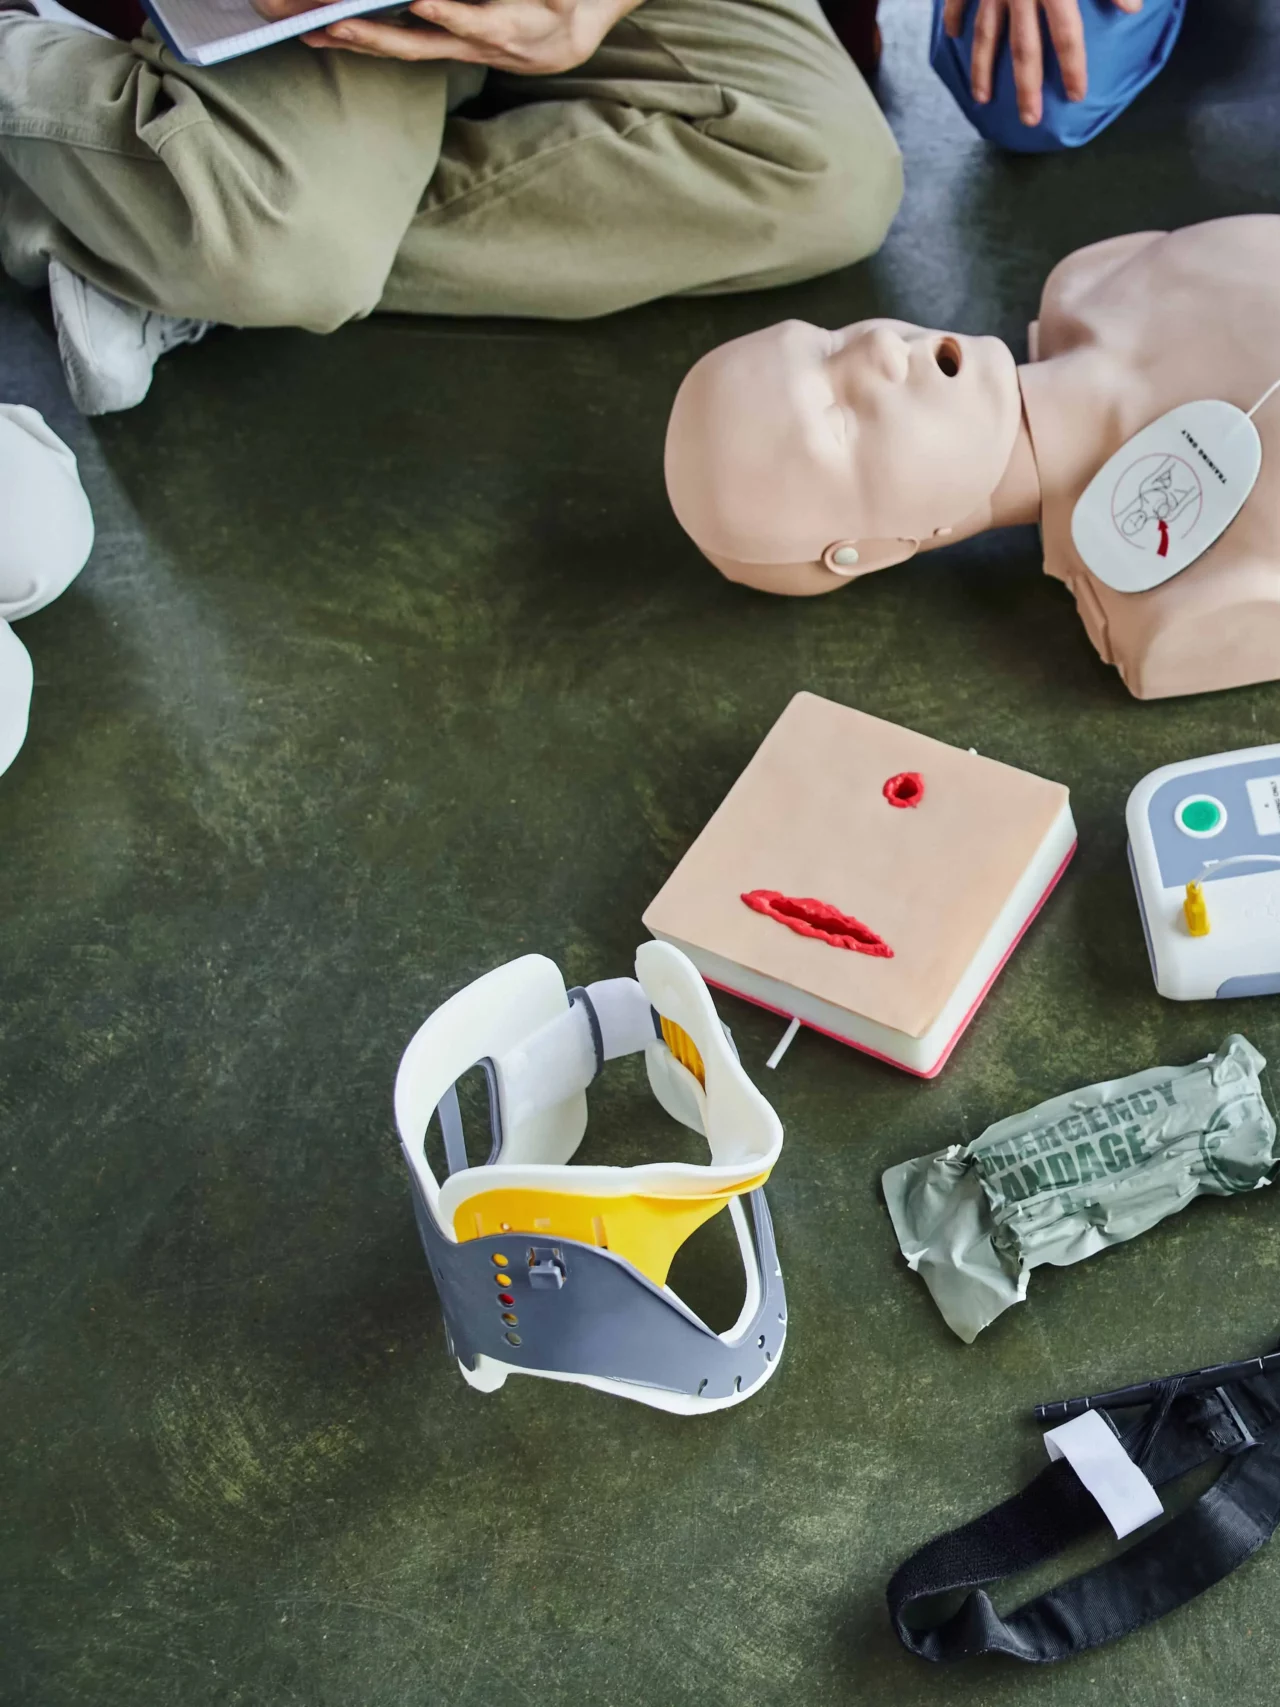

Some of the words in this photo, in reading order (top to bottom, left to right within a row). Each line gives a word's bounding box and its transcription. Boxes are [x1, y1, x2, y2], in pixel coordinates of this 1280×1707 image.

[1181, 429, 1198, 449] ONLY
[1198, 448, 1227, 484] TRAINING
[1270, 781, 1279, 797] ONLY
[979, 1080, 1178, 1177] MERGENCY
[998, 1124, 1151, 1202] ANDAGE
